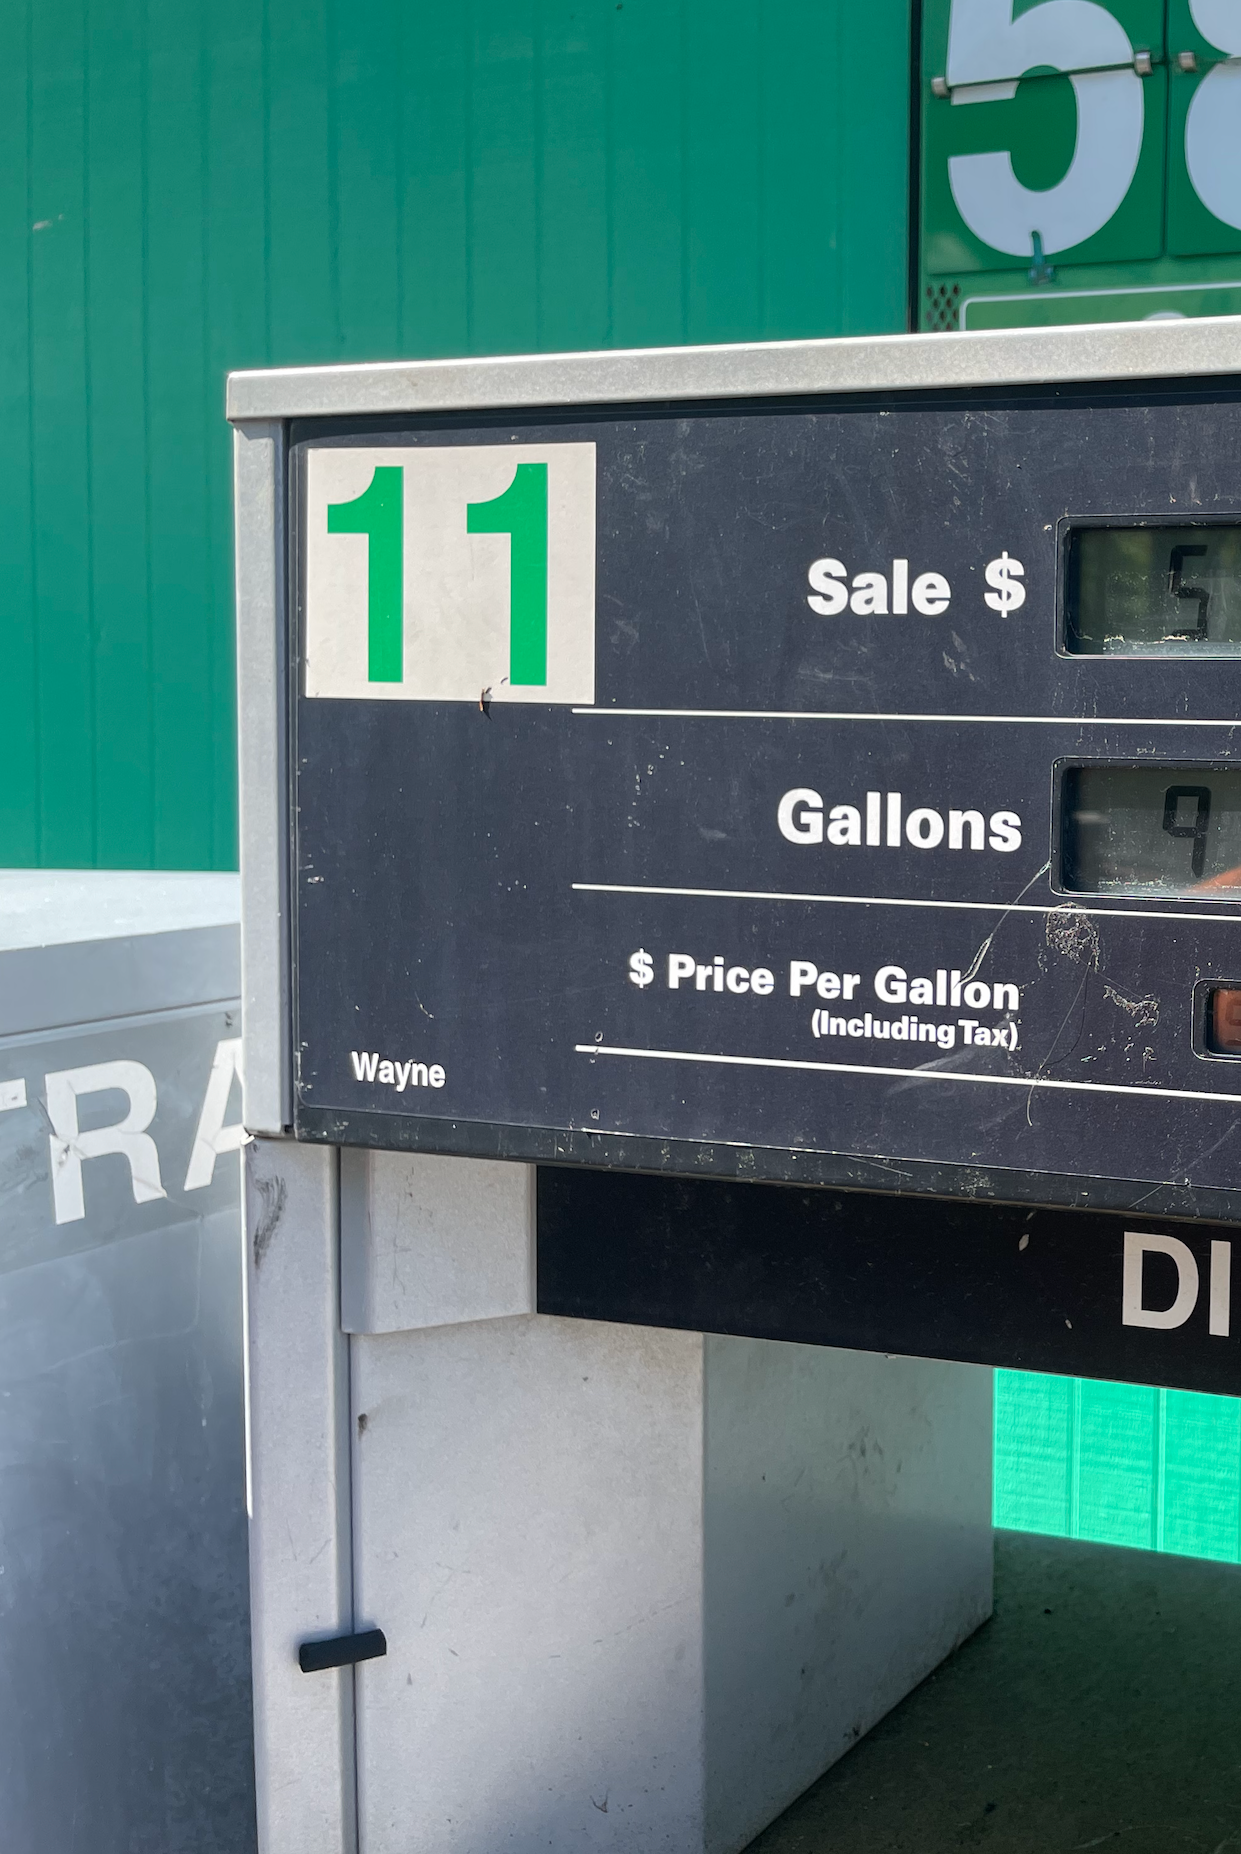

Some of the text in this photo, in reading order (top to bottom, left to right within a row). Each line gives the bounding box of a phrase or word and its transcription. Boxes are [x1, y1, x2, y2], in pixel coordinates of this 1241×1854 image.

[327, 462, 548, 686] 11
[807, 551, 1026, 618] Sale $
[777, 787, 1022, 852] Gallons
[629, 948, 1020, 1010] $ Price Per Gallon
[811, 1008, 1019, 1050] (Including Tax)
[352, 1050, 446, 1092] Wayne
